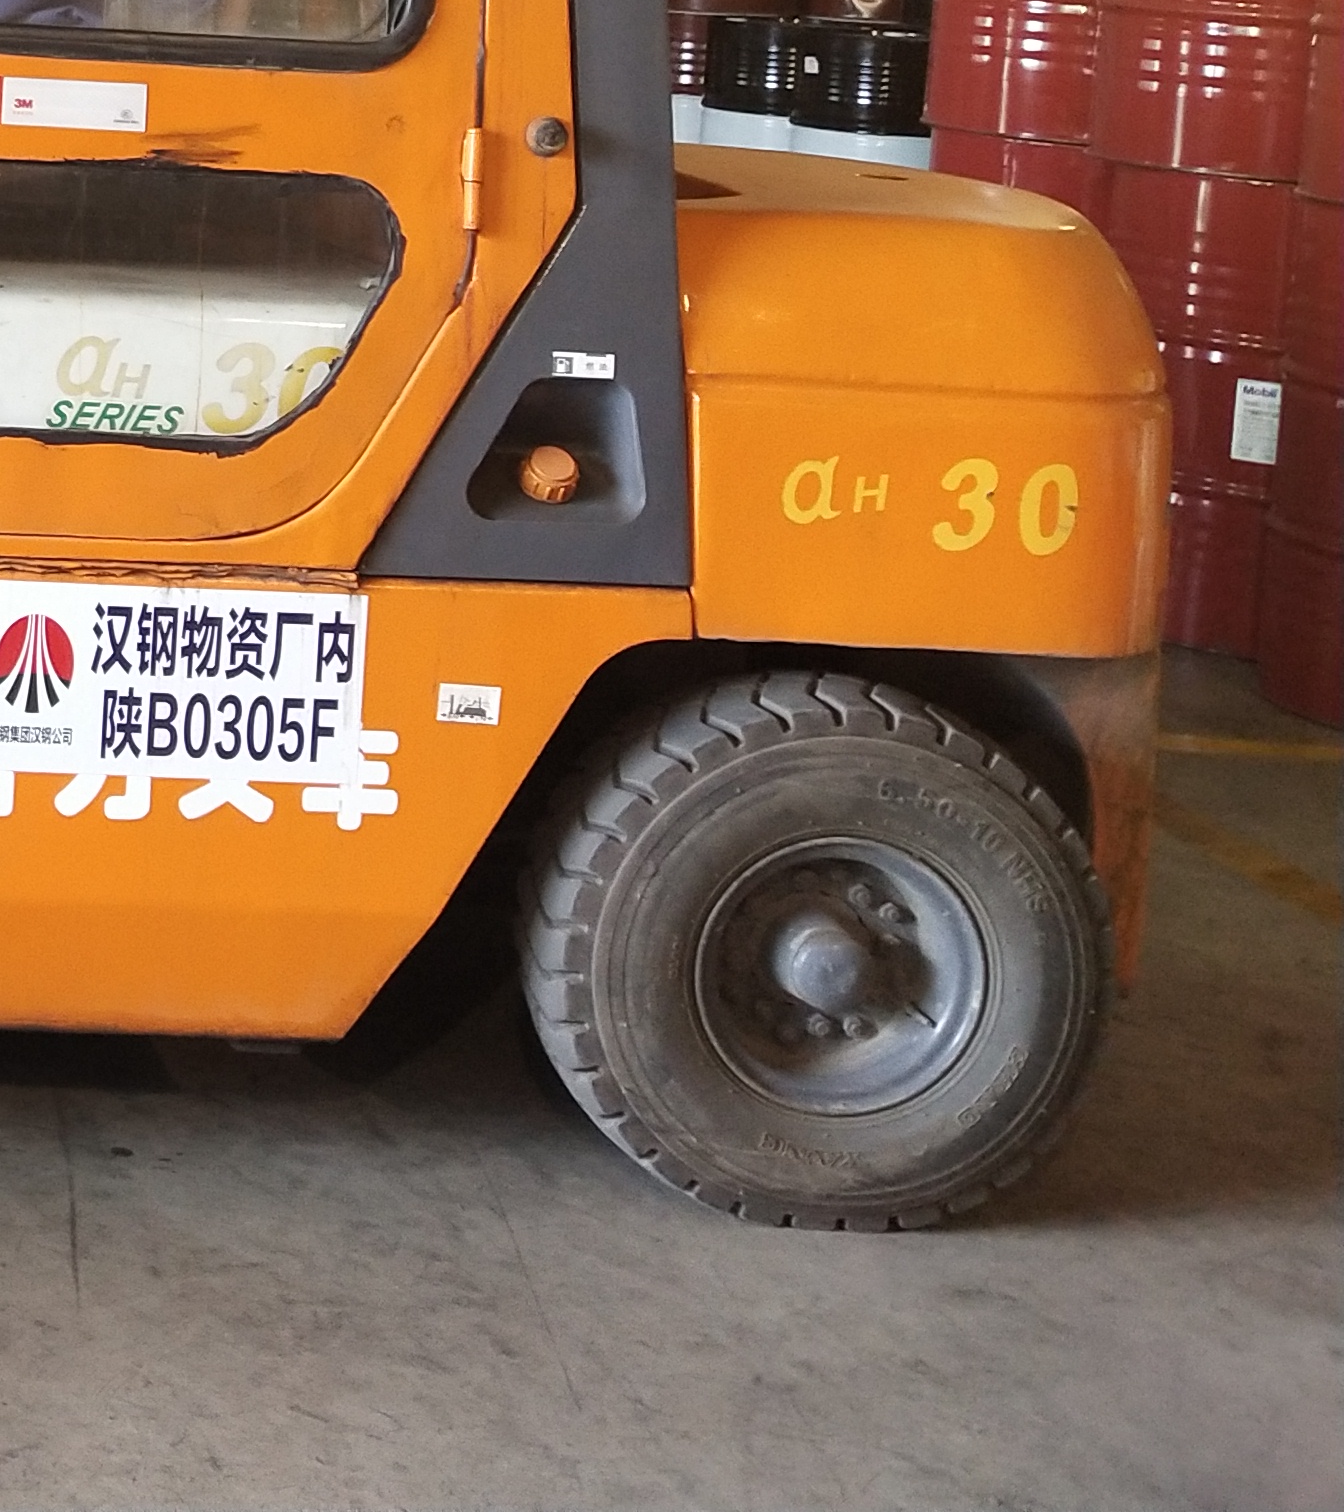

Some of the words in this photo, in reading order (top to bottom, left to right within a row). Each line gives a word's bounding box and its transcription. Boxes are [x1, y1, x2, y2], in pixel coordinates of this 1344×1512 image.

[13, 98, 34, 109] 3M
[45, 399, 186, 434] SERIES
[1242, 384, 1278, 399] Mobil
[931, 457, 1079, 557] 30
[90, 602, 357, 684] 汉钢物资厂内
[100, 686, 340, 764] 陕B0305F
